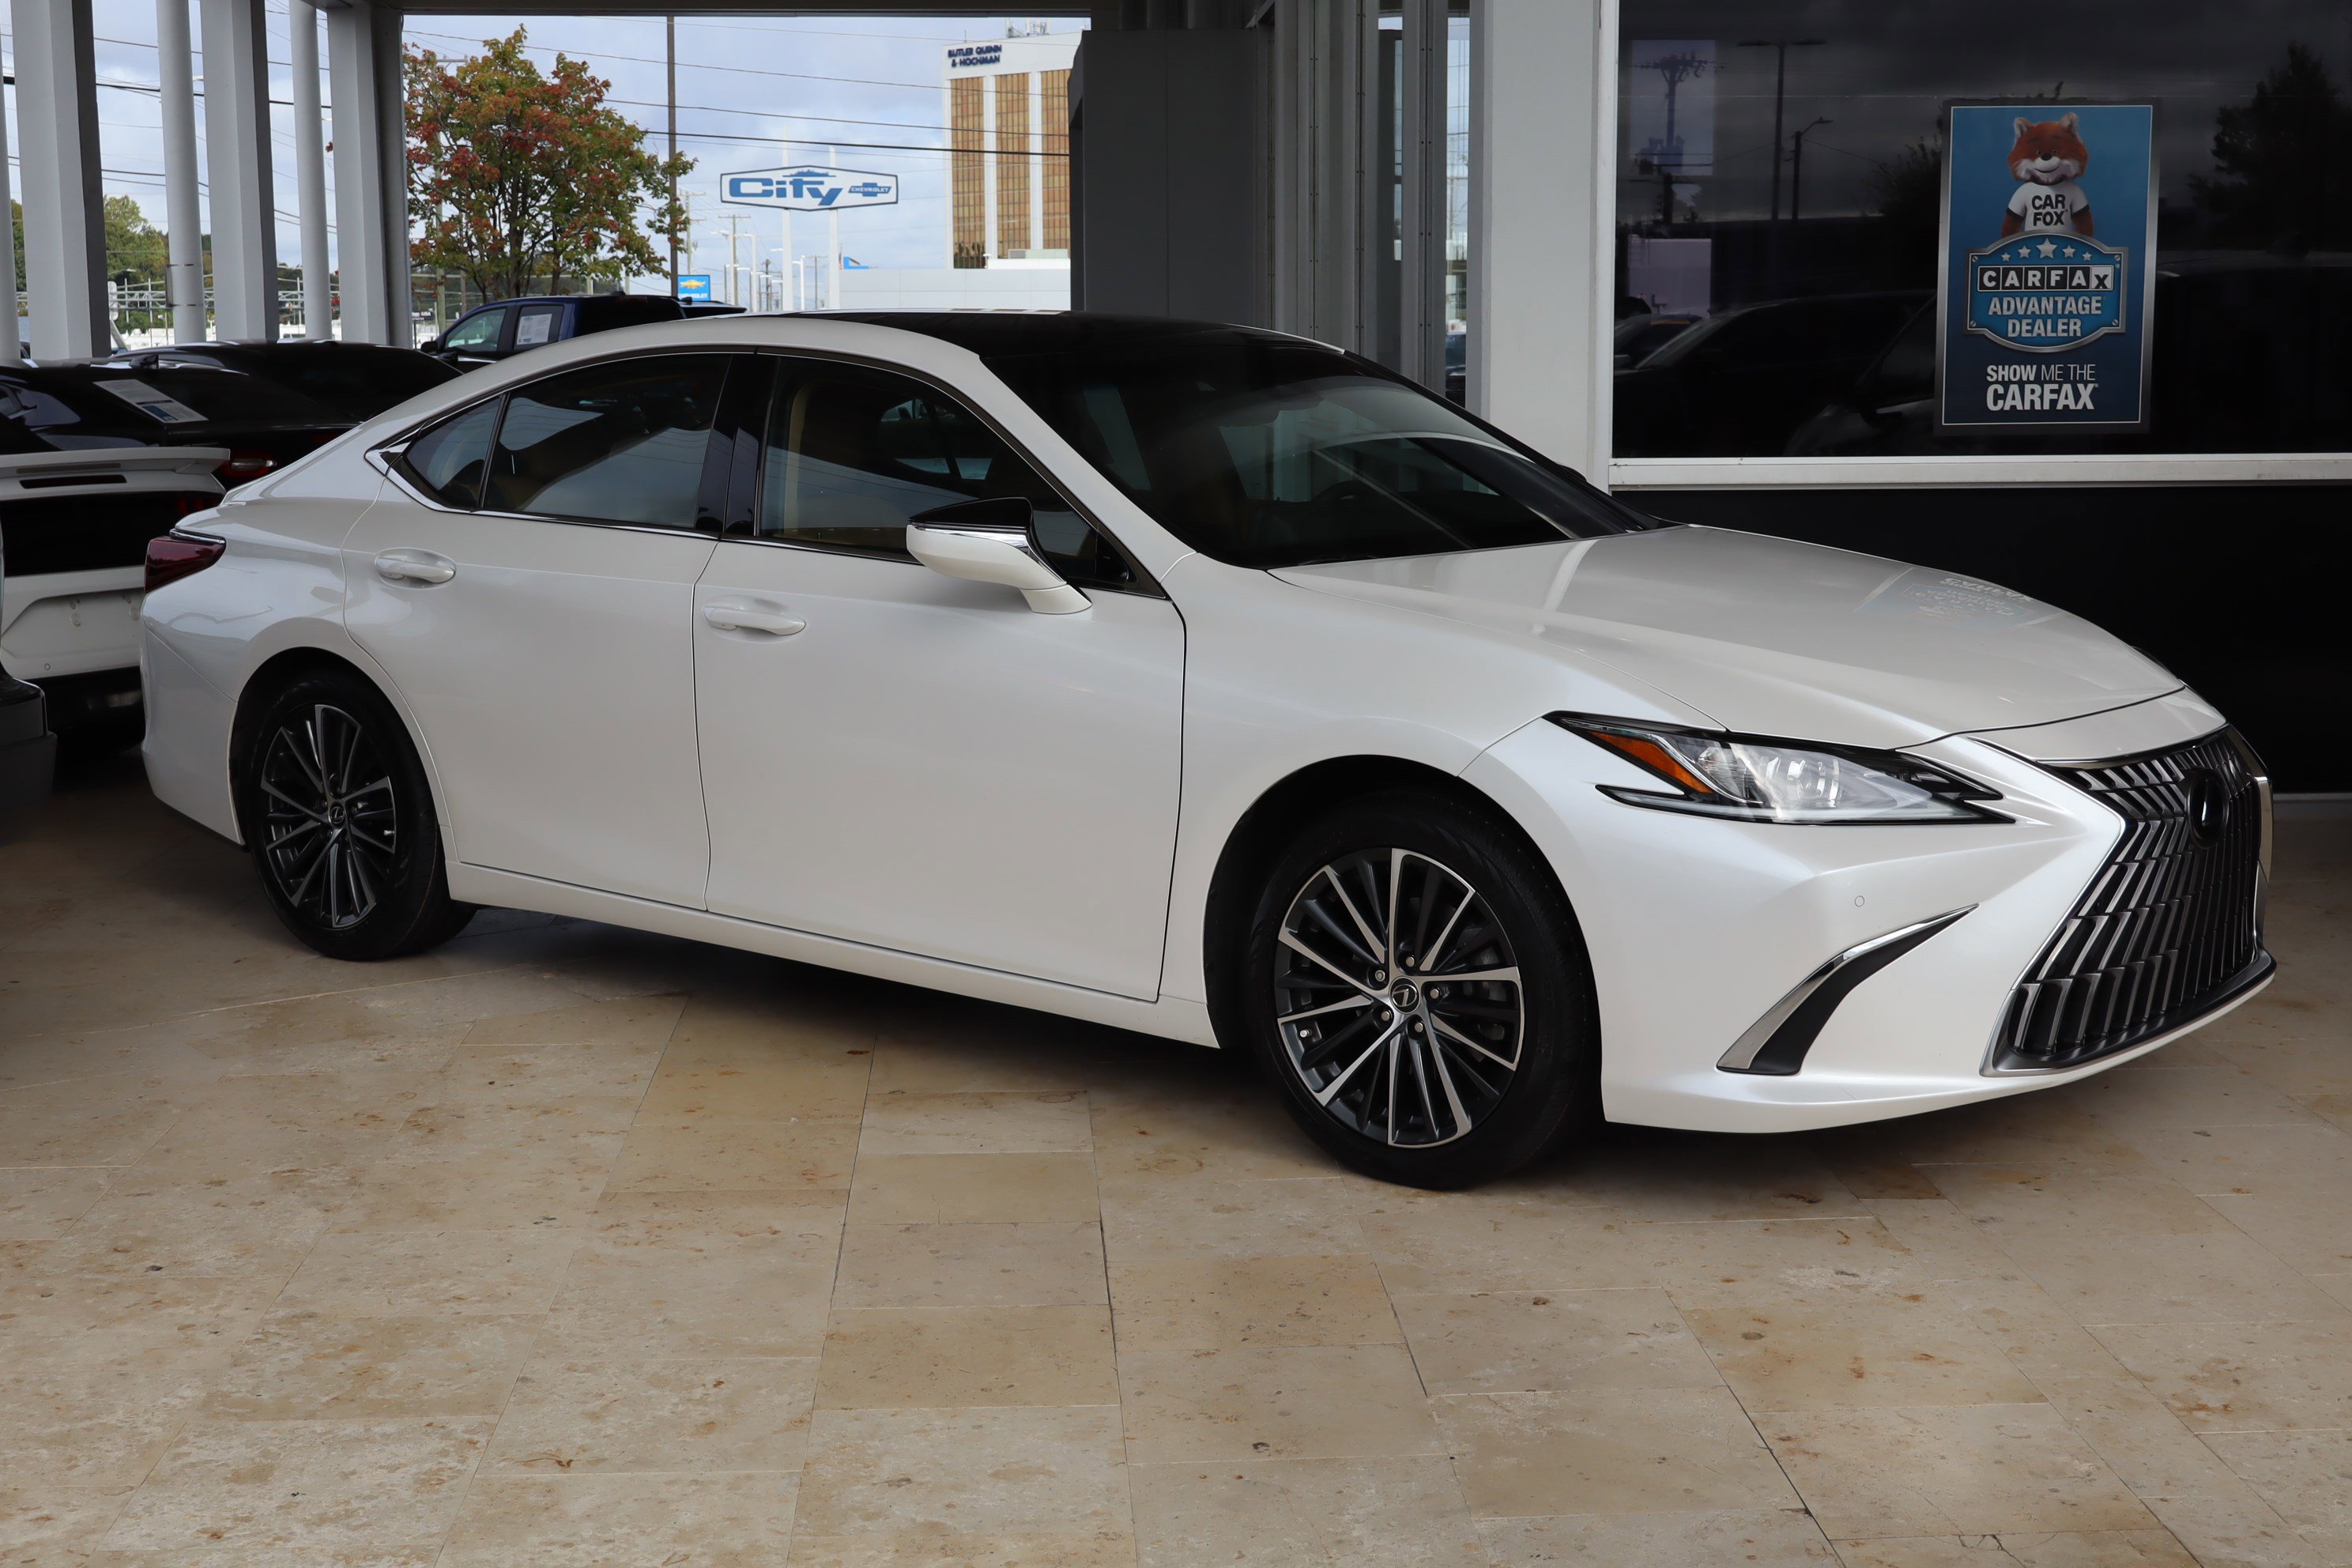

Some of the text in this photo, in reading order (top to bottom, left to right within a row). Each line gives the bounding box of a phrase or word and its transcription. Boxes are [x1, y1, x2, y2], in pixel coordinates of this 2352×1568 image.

[948, 47, 973, 58] BUTLER
[959, 55, 1000, 66] HOCHMAN
[729, 178, 843, 205] City
[2031, 194, 2066, 210] CAR
[2033, 210, 2065, 227] FOX
[1983, 270, 2109, 289] CARFAX
[1988, 296, 2102, 315] ADVANTAGE
[2007, 318, 2082, 337] DEALER
[1986, 364, 2096, 382] SHOW ME THE
[1986, 383, 2095, 411] CARFAX
